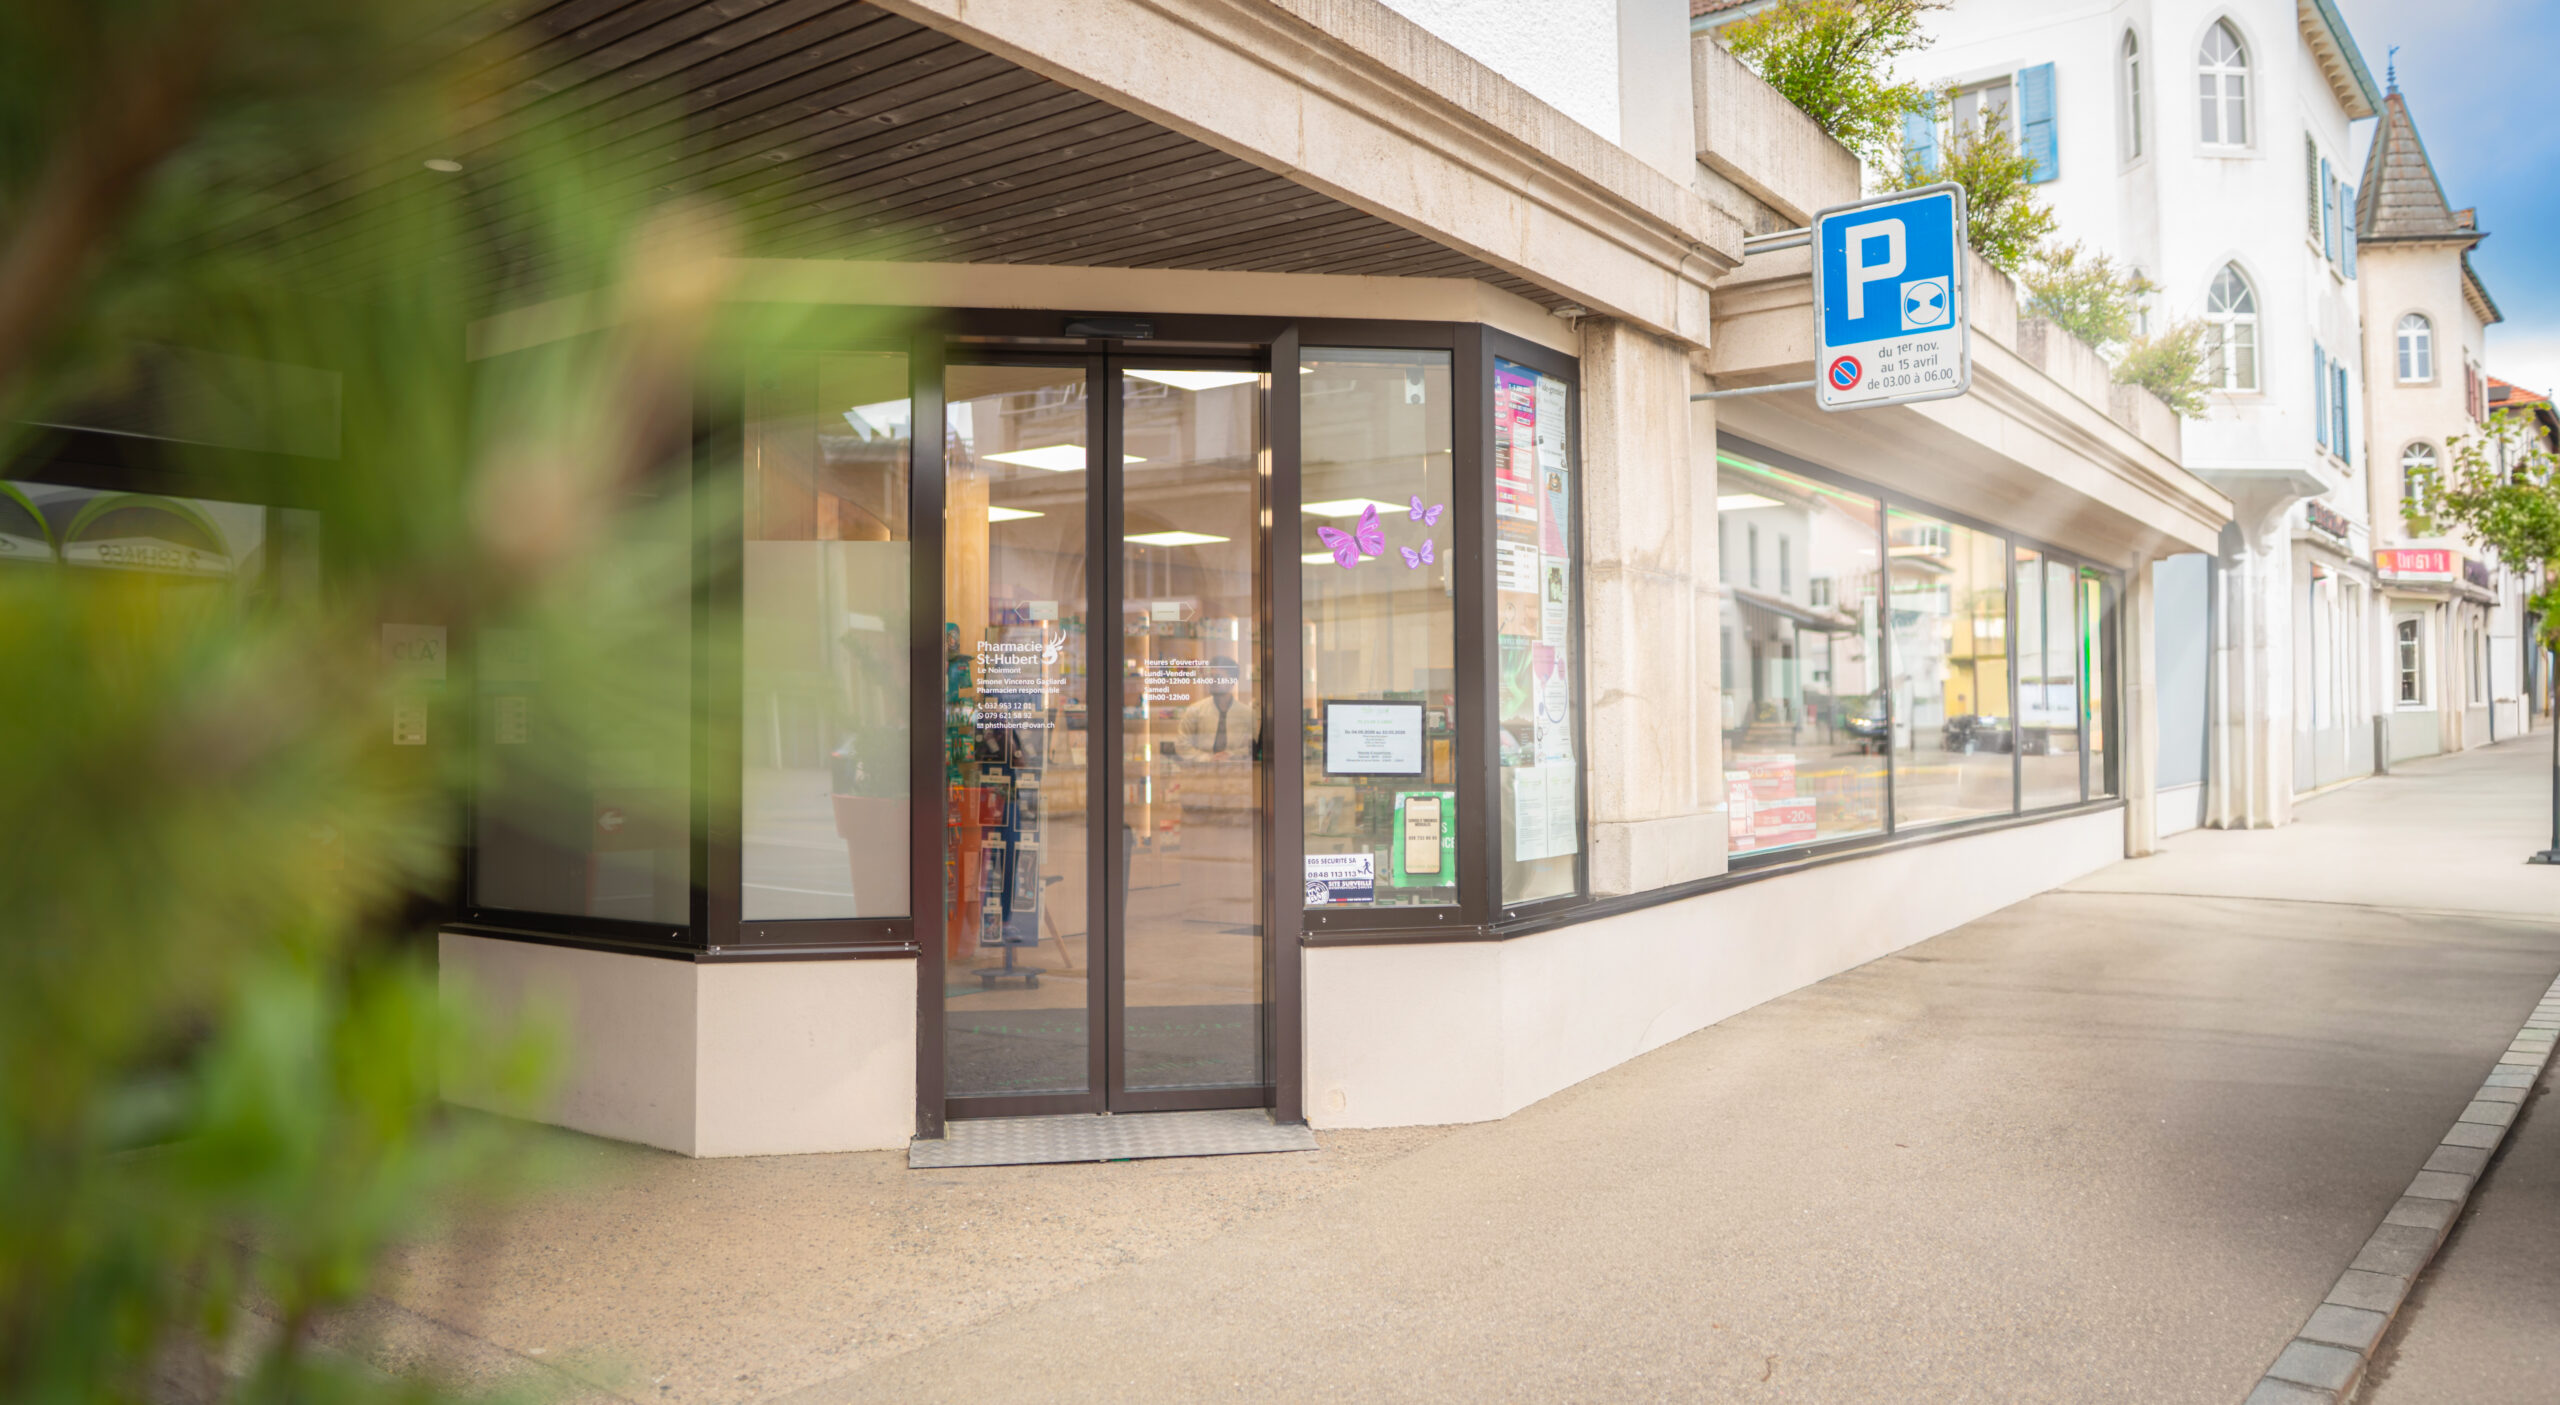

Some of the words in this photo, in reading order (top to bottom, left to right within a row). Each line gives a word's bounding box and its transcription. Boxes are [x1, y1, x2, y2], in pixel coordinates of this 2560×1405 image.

[1845, 218, 1907, 321] P
[1879, 346, 1893, 358] du
[1897, 343, 1913, 355] 1er
[1917, 342, 1939, 352] nov.
[1881, 362, 1895, 373] au
[1899, 360, 1910, 370] 15
[1914, 354, 1938, 367] avril
[1867, 378, 1880, 390] de
[1883, 374, 1911, 387] 03.00
[1914, 372, 1921, 383] à
[1924, 368, 1953, 382] 06.00
[977, 641, 1042, 652] Pharmacie
[976, 653, 1038, 665] St-Hubert
[1170, 658, 1209, 666] d'ouverture
